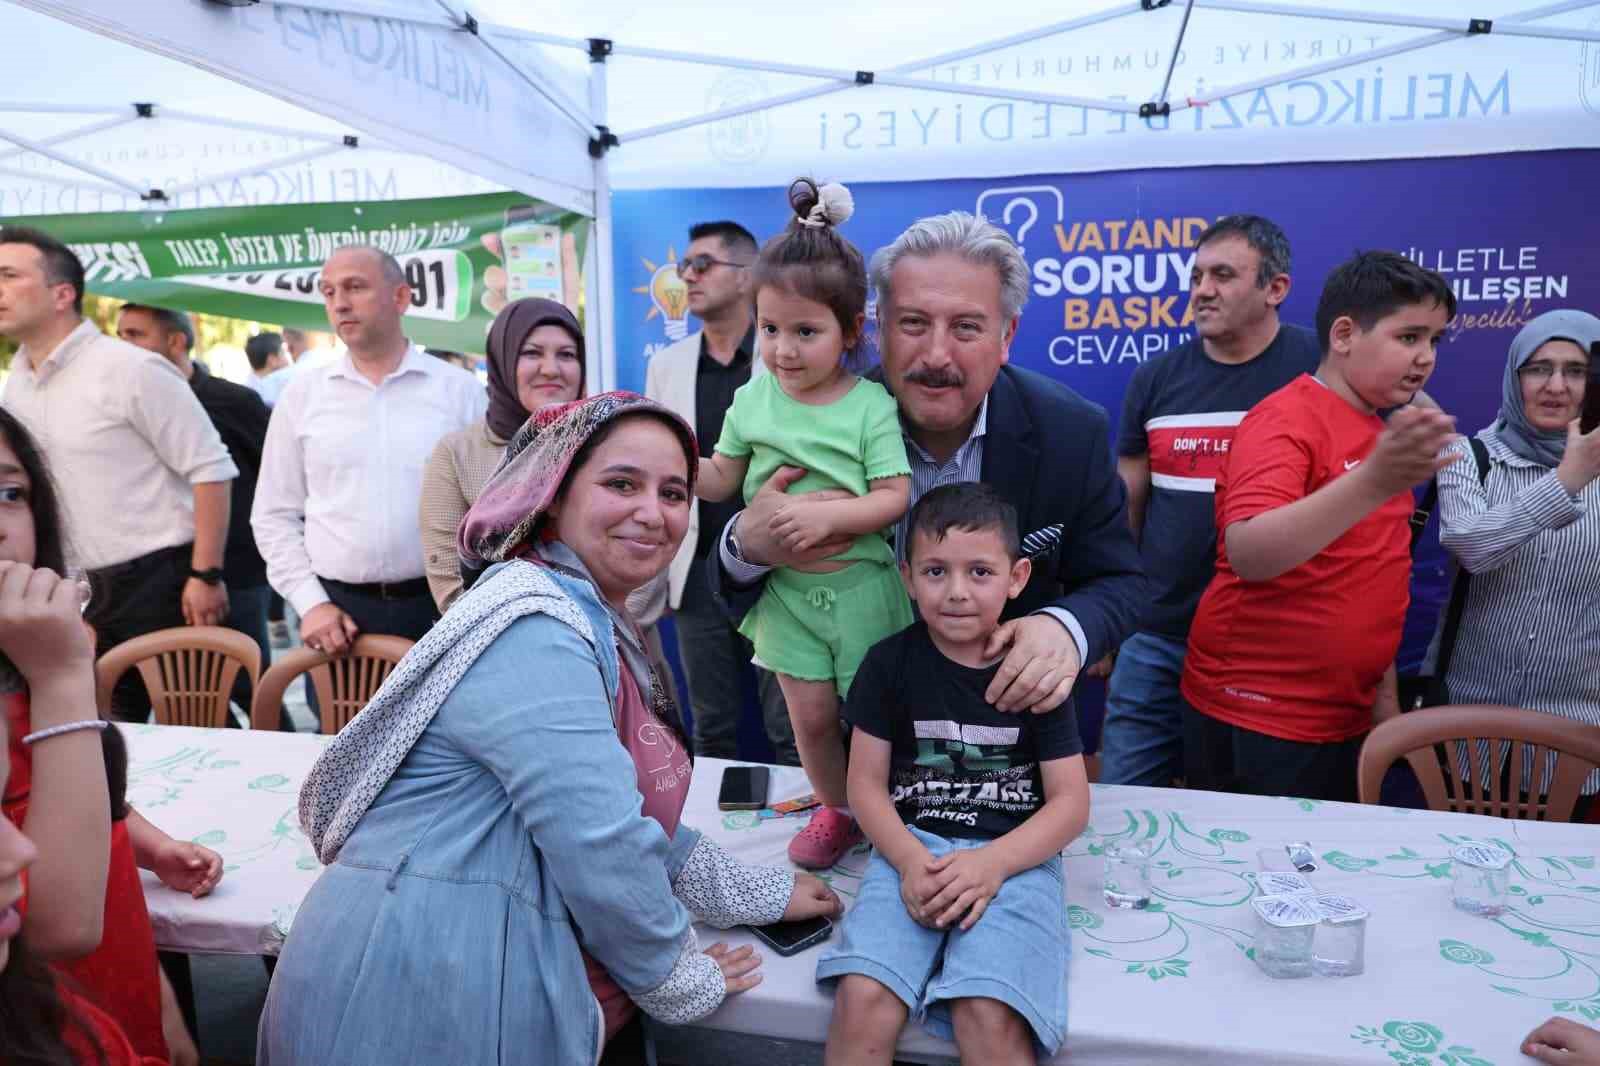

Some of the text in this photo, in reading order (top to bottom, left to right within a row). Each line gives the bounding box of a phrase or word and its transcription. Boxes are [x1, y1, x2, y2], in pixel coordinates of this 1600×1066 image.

[164, 239, 228, 270] TALEP,
[220, 231, 279, 266] İSTEK
[279, 233, 304, 263] VE
[1054, 217, 1208, 252] VATAND
[66, 241, 152, 283] YESİ
[1033, 252, 1196, 297] SORUY
[1401, 247, 1538, 272] İLLETLE
[1064, 296, 1196, 332] BAŞKA
[1213, 438, 1232, 452] LE
